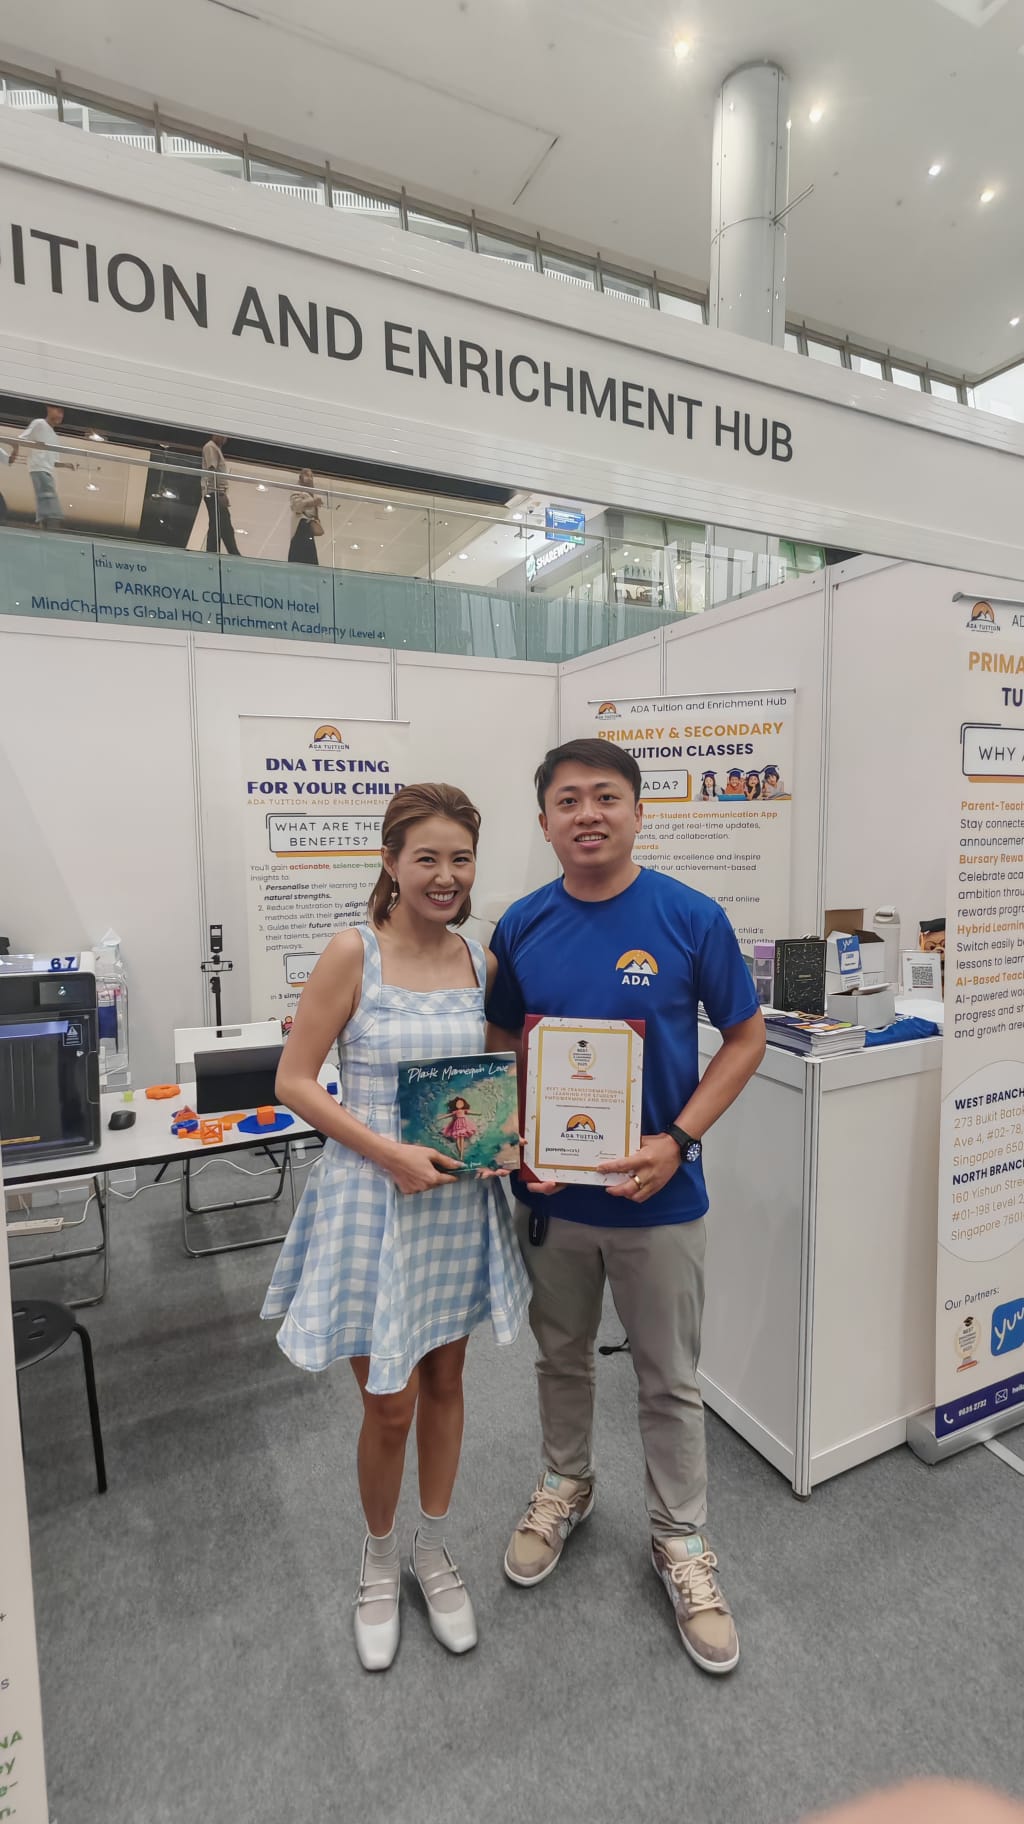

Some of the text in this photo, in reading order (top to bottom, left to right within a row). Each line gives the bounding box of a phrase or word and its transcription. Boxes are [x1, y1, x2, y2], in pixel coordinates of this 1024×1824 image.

[0, 224, 794, 463] ITION AND ENRICHMENT HUB
[95, 559, 147, 572] this way to
[115, 581, 320, 613] PARKROYAL COLLECTION Hotel
[31, 596, 130, 618] MindChamps
[133, 605, 178, 621] Global
[182, 610, 204, 624] HQ
[216, 613, 288, 632] Enrichment
[291, 621, 346, 639] Academy
[349, 628, 375, 639] (Level
[631, 697, 787, 714] ADA Tuition and Enrichment Hub
[597, 722, 784, 741] PRIMARY & SECONDARY
[686, 743, 754, 757] CLASSES
[978, 746, 1016, 761] WHY
[266, 758, 390, 773] DNA TESTING
[247, 781, 288, 795] FOR
[293, 782, 346, 795] YOUR
[642, 780, 679, 791] ADA?
[692, 811, 778, 820] Communication App
[275, 822, 381, 832] WHAT ARE THE
[672, 823, 685, 831] get
[686, 822, 724, 830] real-time
[725, 821, 761, 830] updates,
[960, 819, 983, 831] Stay
[289, 837, 369, 847] BENEFITS?
[676, 832, 731, 840] collaboration.
[633, 853, 761, 862] academic excellence and inspire
[959, 854, 998, 866] Bursary
[271, 864, 289, 872] gain
[959, 871, 1005, 882] Celebrate
[266, 883, 310, 891] Personalise
[293, 893, 333, 901] strengths.
[958, 889, 1000, 900] ambition
[334, 911, 361, 919] genetic
[957, 906, 997, 917] rewards
[957, 923, 991, 937] Hybrid
[956, 939, 1014, 952] Switch easily
[956, 957, 1003, 970] lessons to
[621, 975, 650, 986] ADA
[956, 973, 1000, 987] AI-Based
[955, 989, 1008, 1005] AI-powered
[954, 1005, 1014, 1024] progress and
[954, 1023, 1006, 1039] and growth
[408, 1068, 438, 1084] Plastic
[488, 1062, 509, 1075] Love
[955, 1096, 984, 1110] WEST
[954, 1111, 998, 1129] 273 Bukit
[953, 1136, 974, 1148] Ave
[976, 1132, 984, 1145] 4,
[953, 1145, 1003, 1167] Singapore
[952, 1159, 1024, 1185] NORTH BRANC
[952, 1191, 969, 1204] 160
[971, 1182, 1002, 1200] Yishun
[992, 1195, 1016, 1211] Level
[951, 1218, 1001, 1241] Singapore
[944, 1287, 1000, 1311] Our Partners:
